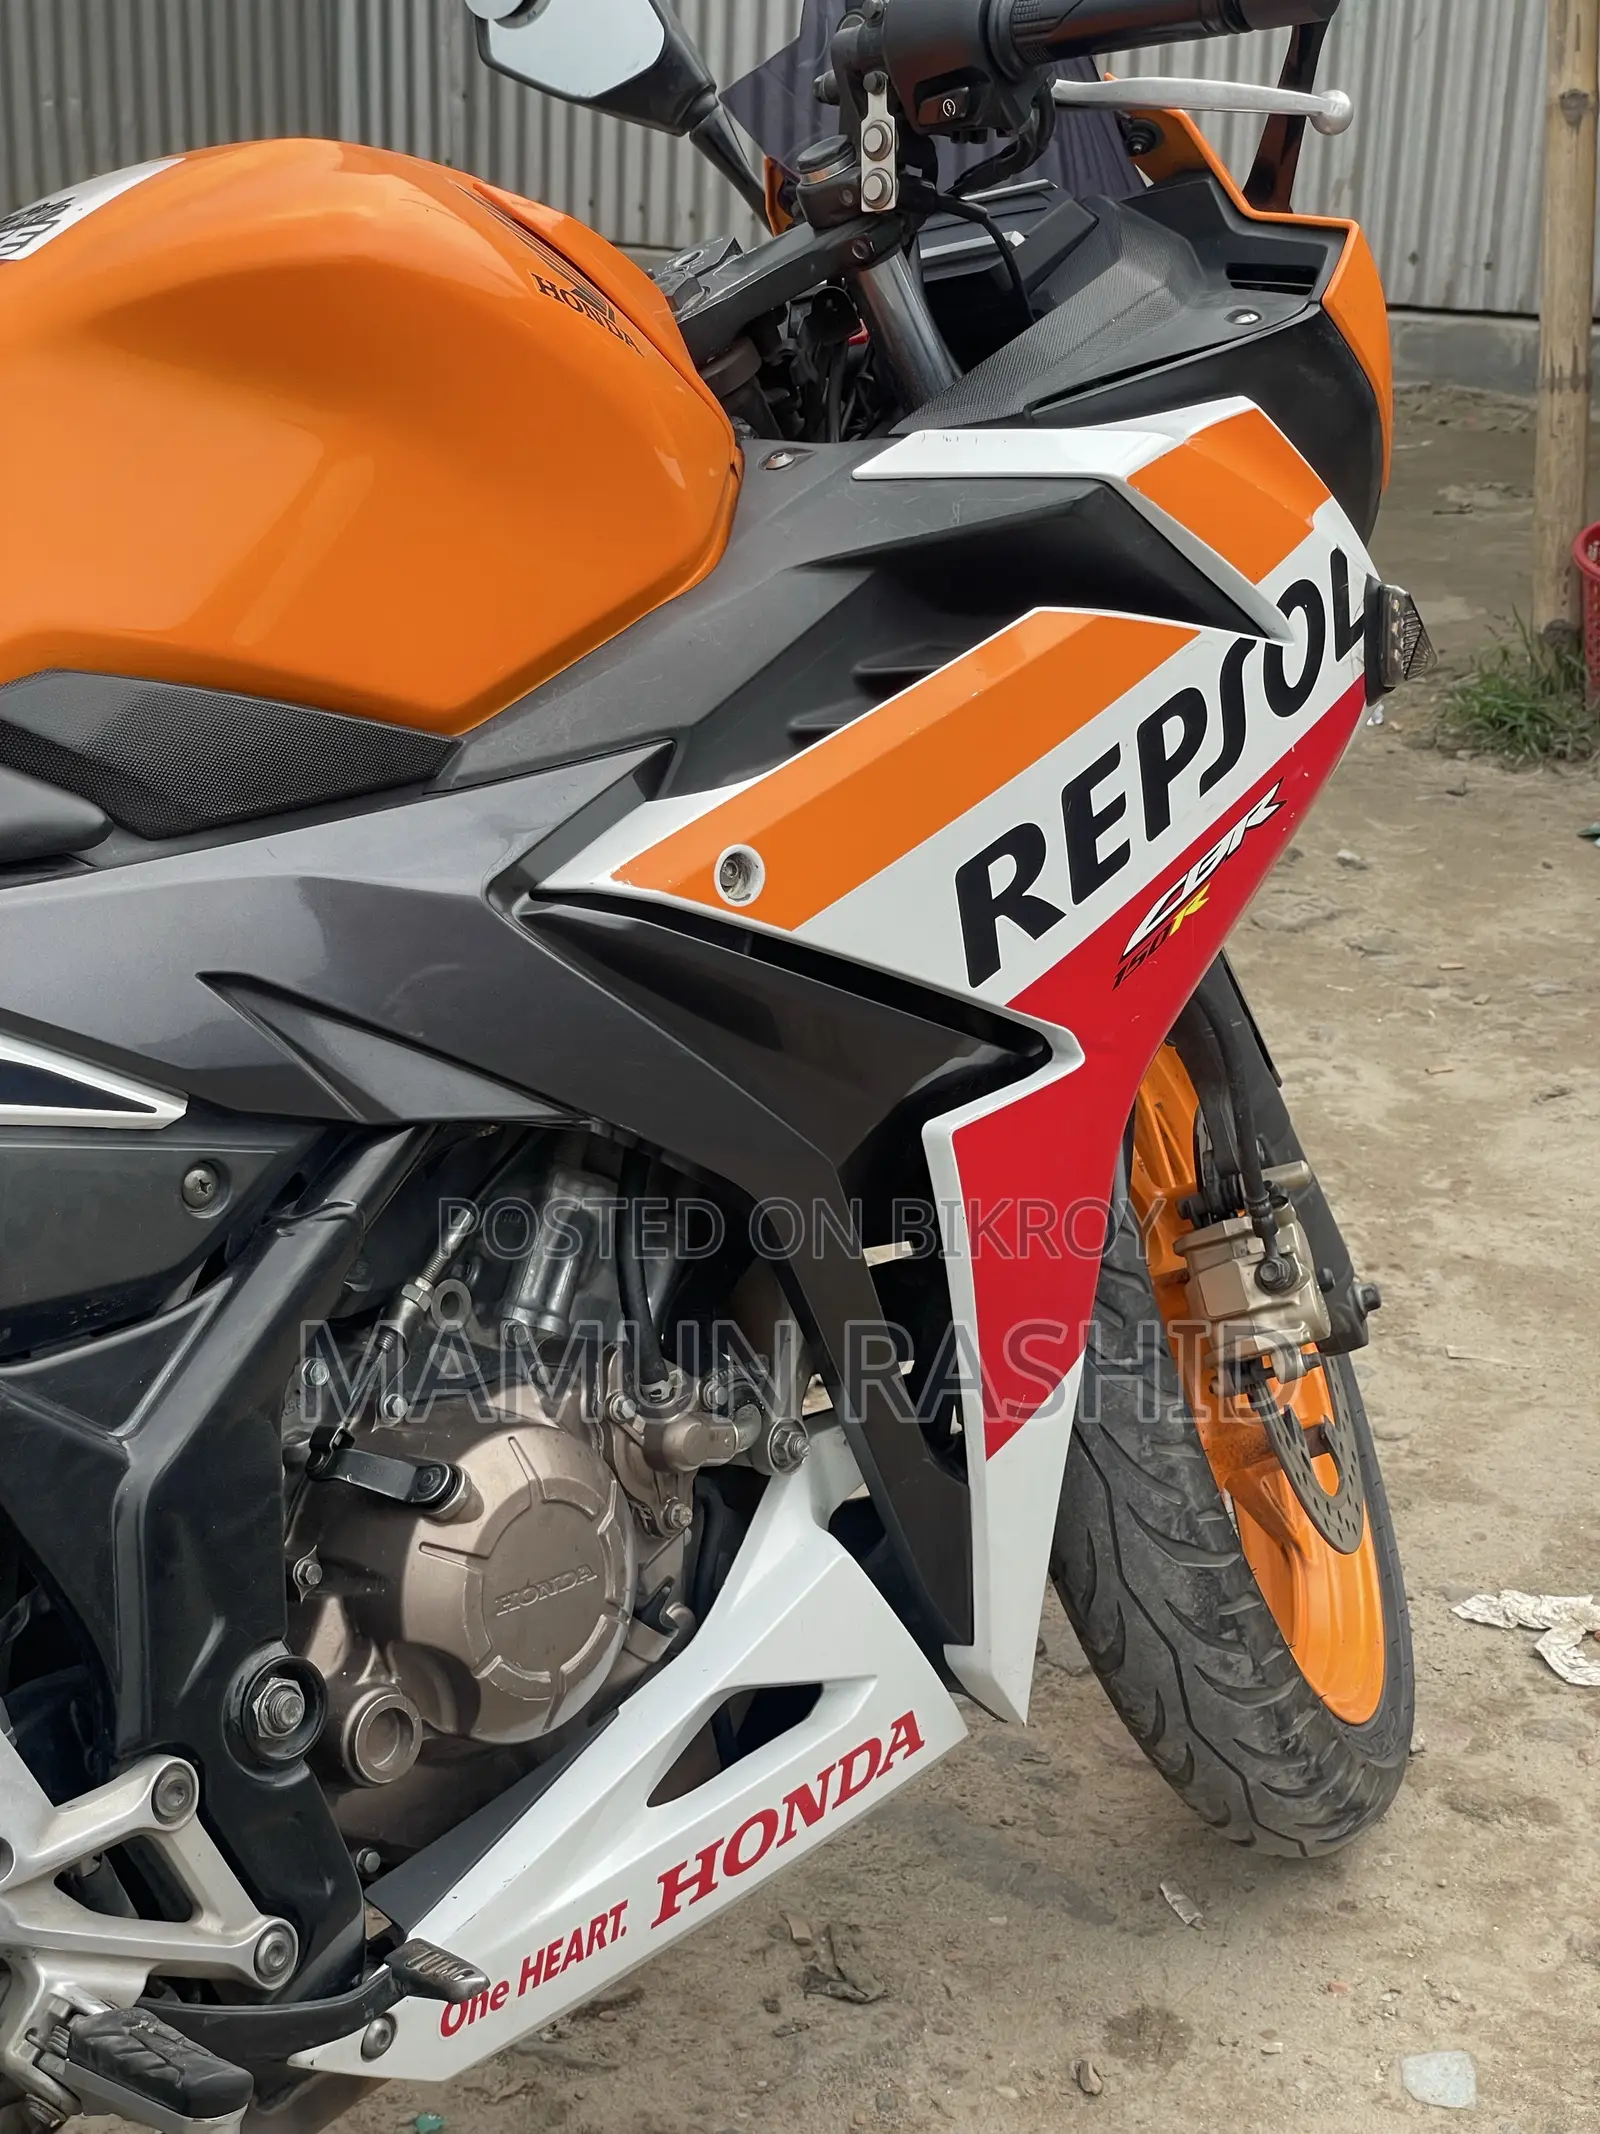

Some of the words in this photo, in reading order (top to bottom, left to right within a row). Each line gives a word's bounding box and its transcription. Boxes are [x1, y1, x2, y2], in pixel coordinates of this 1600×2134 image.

[529, 271, 645, 358] HONDA
[955, 545, 1366, 989] REPSOL
[1118, 776, 1288, 966] CBR
[494, 1564, 598, 1617] HONDA
[440, 1980, 510, 2038] One
[517, 1899, 629, 1998] HEART.
[650, 1710, 925, 1930] HONDA
